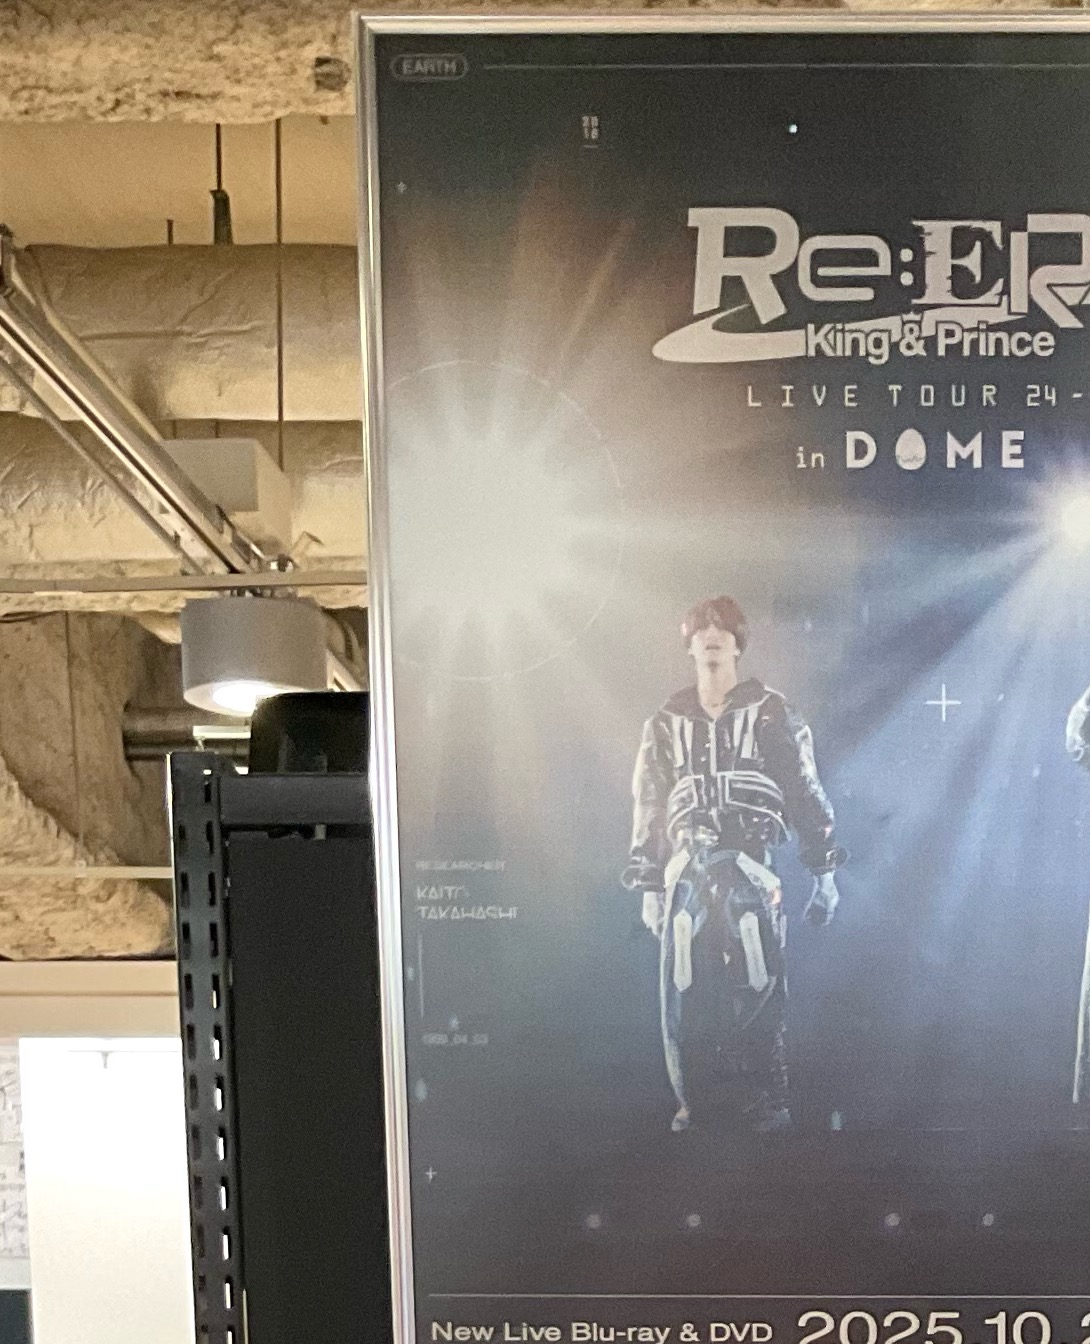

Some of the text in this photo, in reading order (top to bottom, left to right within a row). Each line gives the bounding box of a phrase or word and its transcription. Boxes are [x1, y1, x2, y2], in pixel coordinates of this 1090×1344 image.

[806, 322, 1053, 364] King & Prince
[746, 384, 858, 407] LIVE
[889, 384, 997, 407] TOUR
[796, 446, 825, 470] in
[431, 1321, 494, 1342] New
[503, 1322, 562, 1342] Live
[680, 1323, 700, 1342] &
[709, 1322, 773, 1342] DVD
